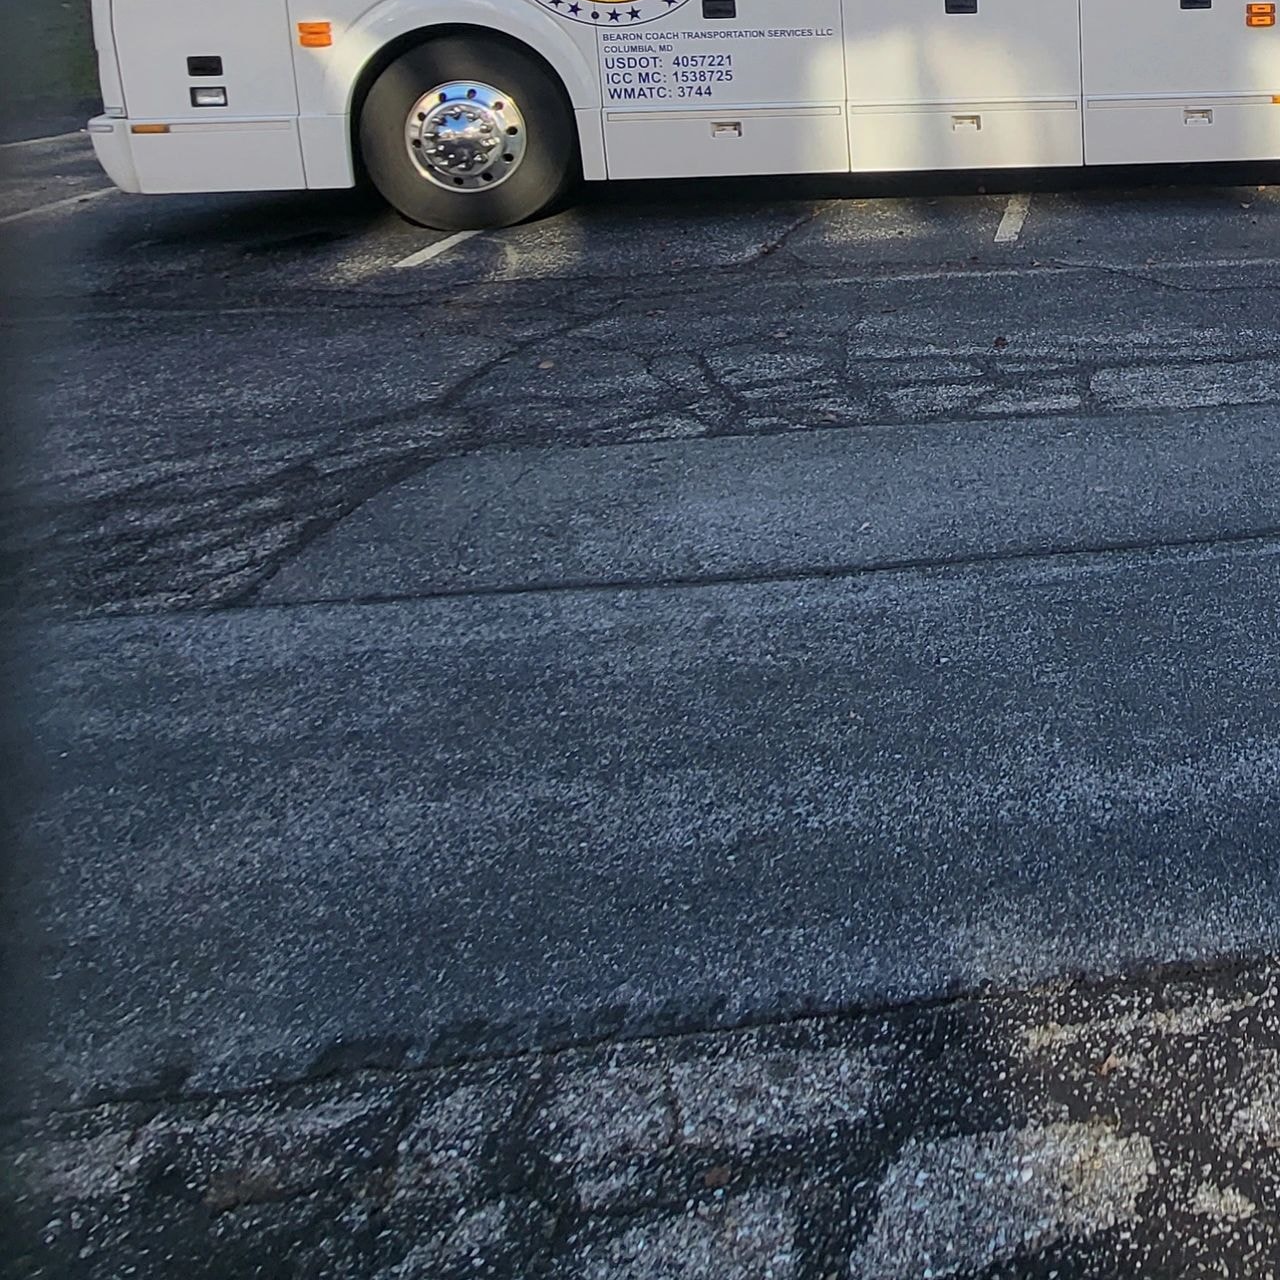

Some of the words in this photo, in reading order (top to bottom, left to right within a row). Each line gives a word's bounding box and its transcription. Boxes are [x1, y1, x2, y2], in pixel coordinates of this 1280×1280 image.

[602, 32, 643, 41] BEARON
[645, 31, 680, 40] COACH
[681, 30, 765, 39] TRANSPORTATION
[767, 29, 813, 38] SERVICES
[815, 28, 833, 36] LLC
[603, 45, 657, 53] COLUMBIA,
[658, 44, 673, 52] MD
[605, 57, 664, 69] USDOT:
[672, 55, 733, 67] 4057221
[606, 73, 634, 84] ICC
[638, 72, 667, 83] MC:
[673, 71, 733, 82] 1538725
[609, 87, 673, 99] WMATC:
[677, 86, 712, 98] 3744
